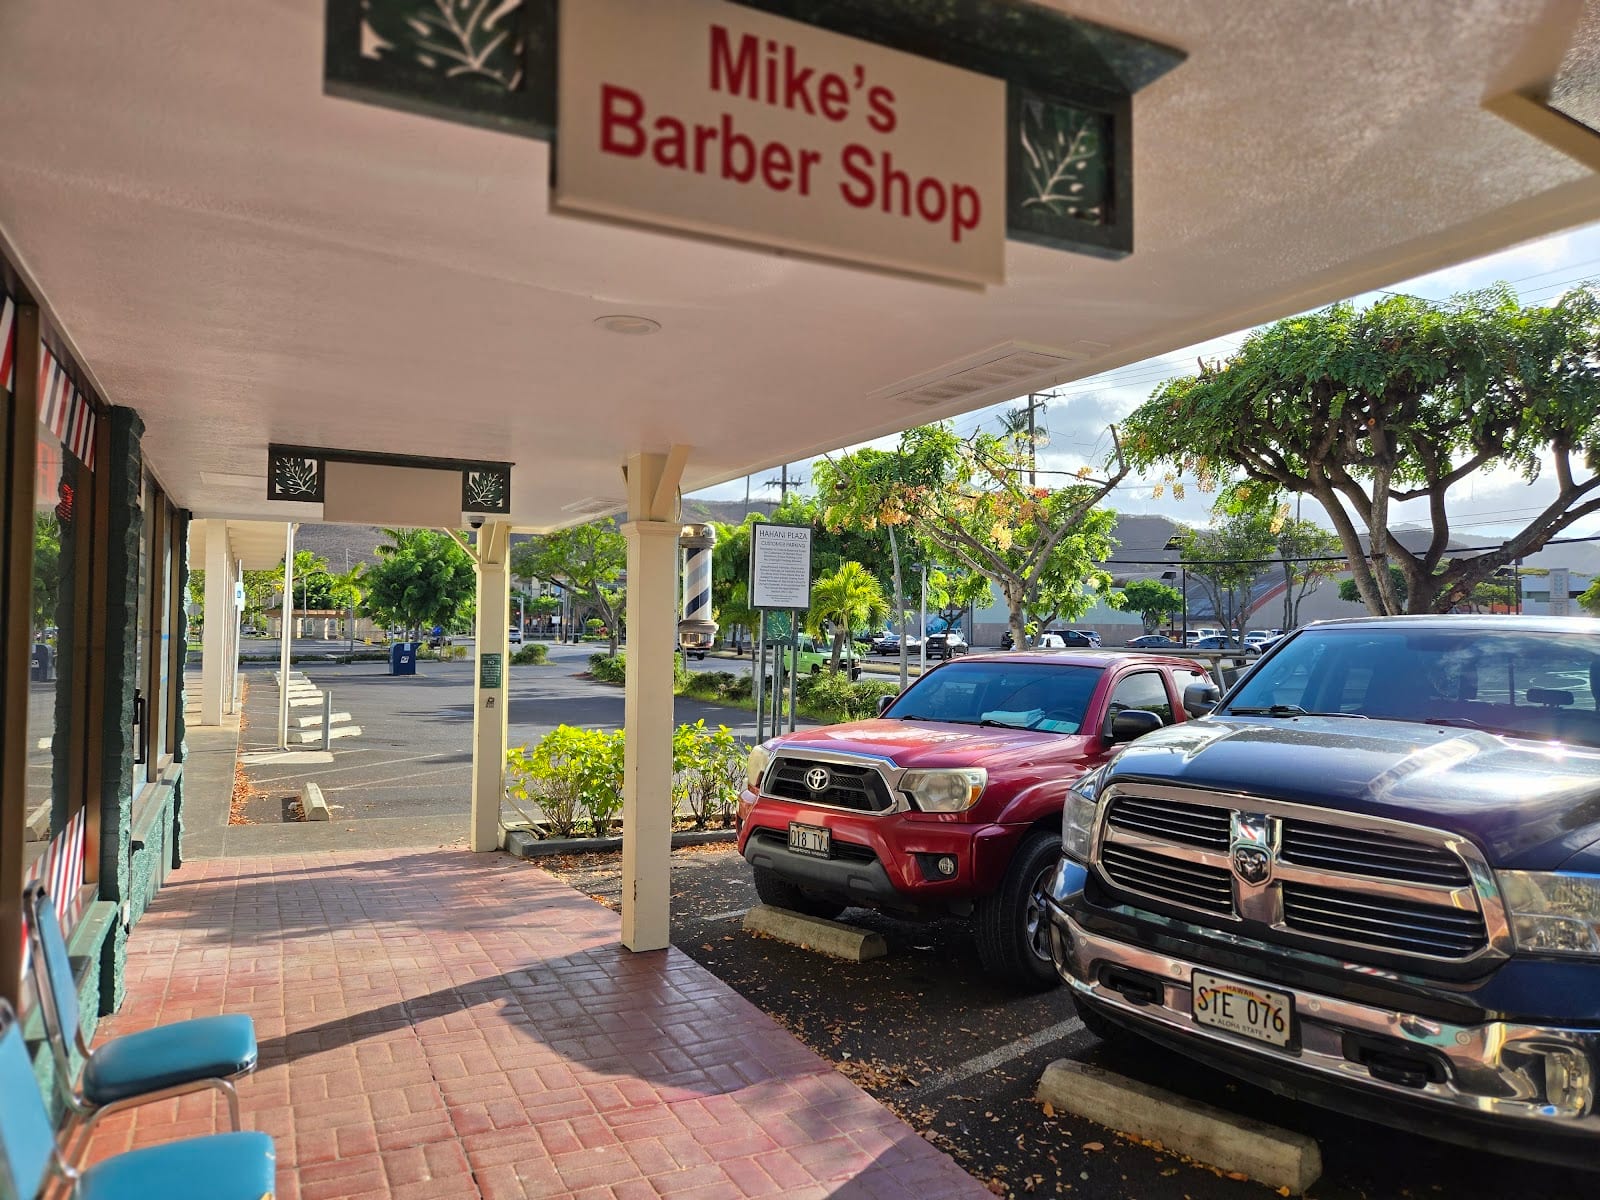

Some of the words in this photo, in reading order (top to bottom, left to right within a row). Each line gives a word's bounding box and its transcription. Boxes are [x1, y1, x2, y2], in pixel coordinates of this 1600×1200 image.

[709, 25, 898, 133] Mike's
[599, 82, 821, 197] Barber
[839, 142, 983, 243] Shop
[759, 530, 786, 539] HAHANI
[787, 531, 808, 540] PLAZA
[790, 829, 807, 848] 018
[1198, 985, 1235, 1020] STE
[1246, 999, 1285, 1033] 076
[1217, 1018, 1240, 1030] ALOHA
[1241, 1024, 1264, 1036] STATE
